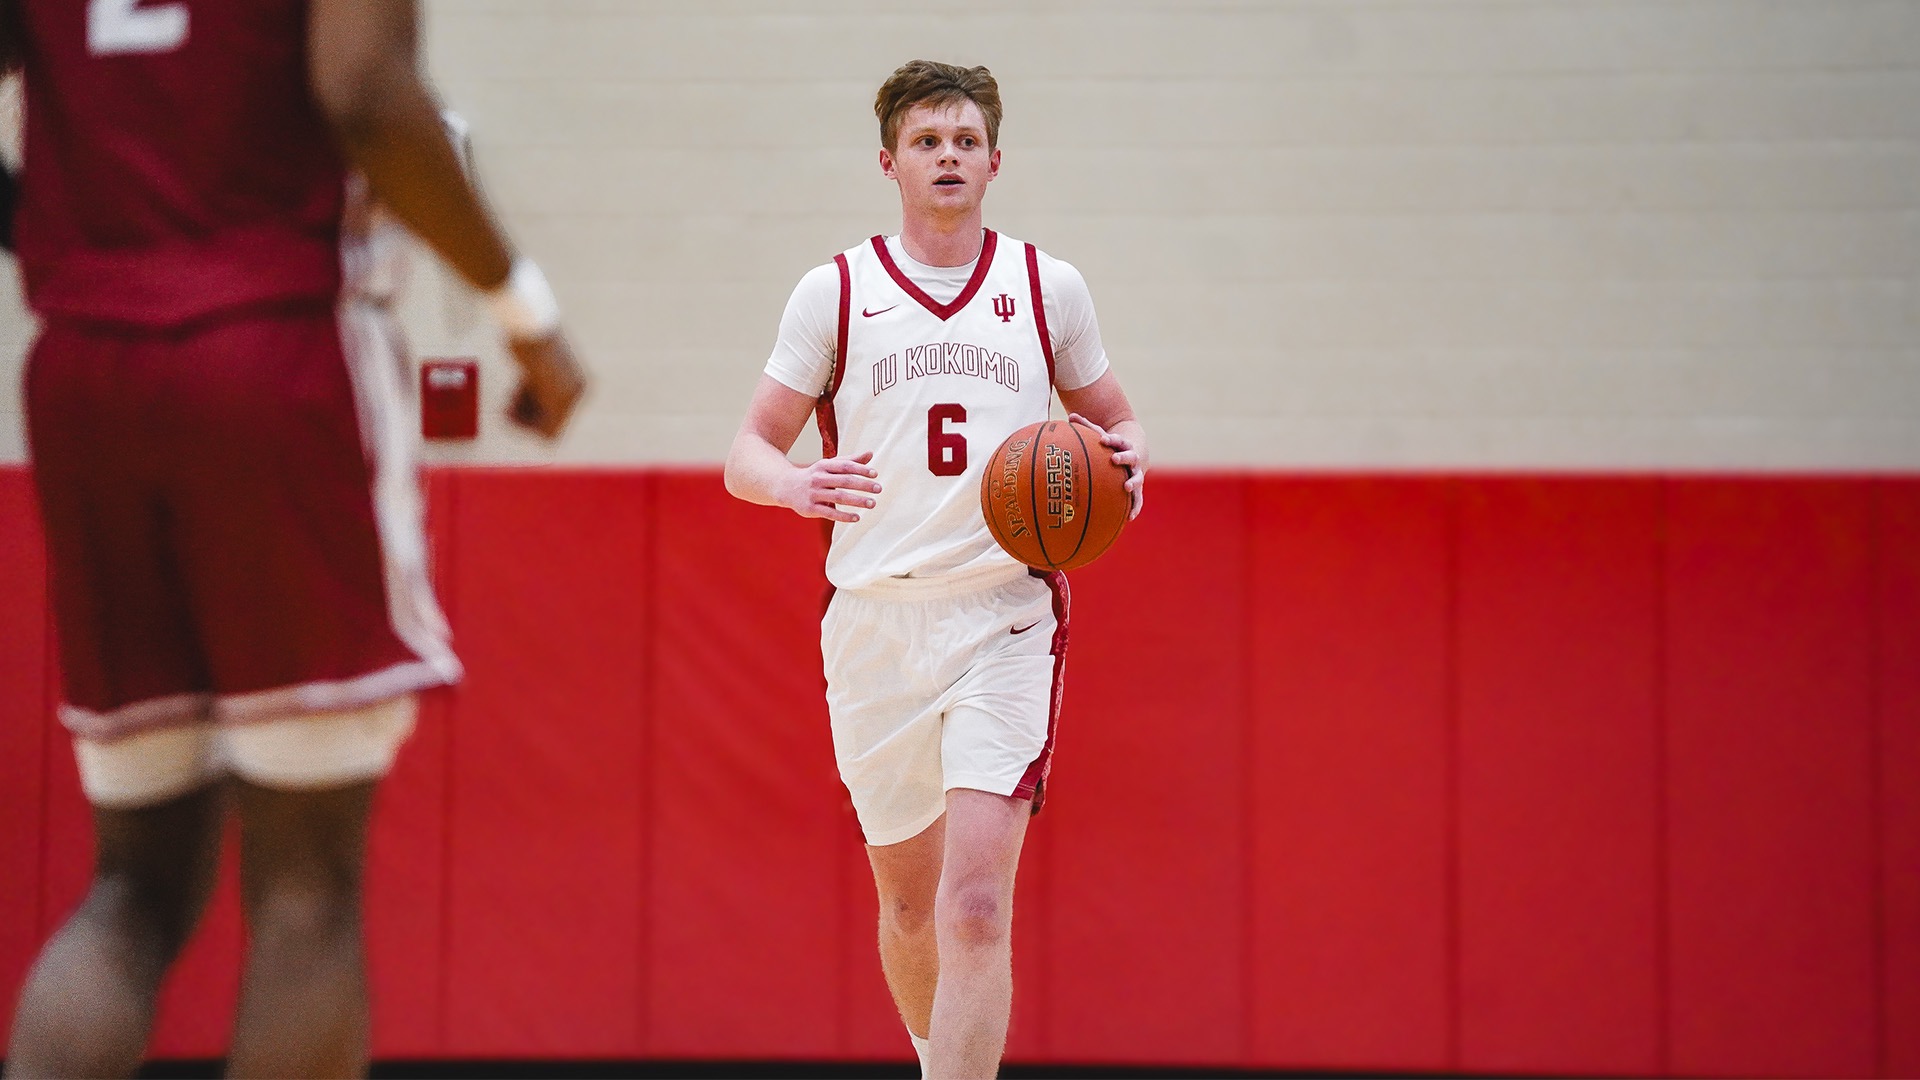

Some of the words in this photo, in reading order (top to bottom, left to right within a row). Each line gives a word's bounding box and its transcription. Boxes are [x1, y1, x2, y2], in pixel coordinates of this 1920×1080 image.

[872, 353, 897, 396] IU
[906, 342, 1020, 393] KOKOMO
[927, 403, 968, 476] 6
[1063, 450, 1073, 502] 1000
[1004, 436, 1032, 538] SPALDING
[1045, 443, 1064, 529] LEGACY
